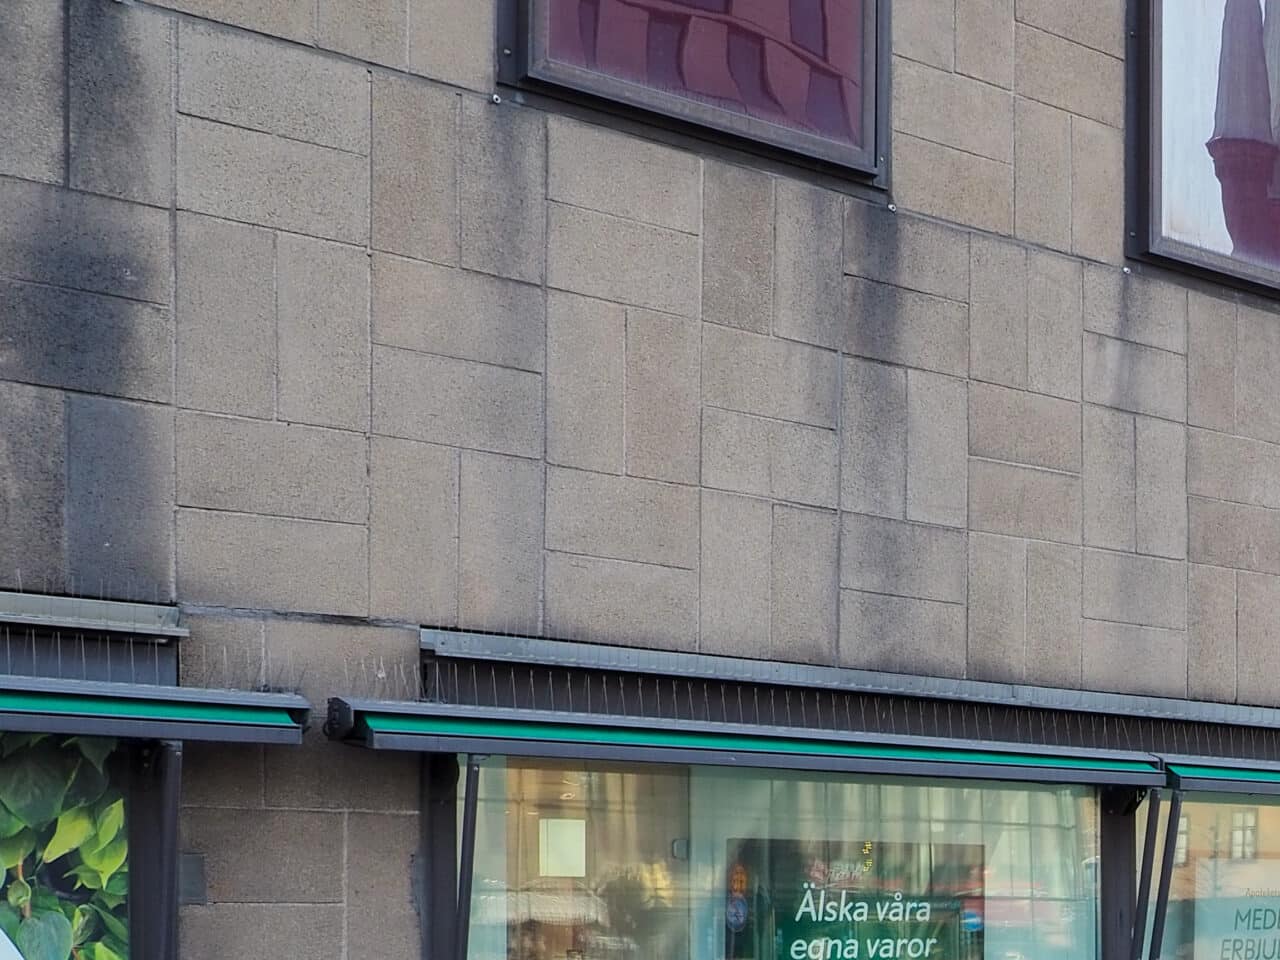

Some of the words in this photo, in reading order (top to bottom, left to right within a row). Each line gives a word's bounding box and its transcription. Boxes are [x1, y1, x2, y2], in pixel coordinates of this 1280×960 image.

[794, 882, 869, 922] Älska
[875, 892, 931, 922] våra
[866, 937, 938, 958] varor
